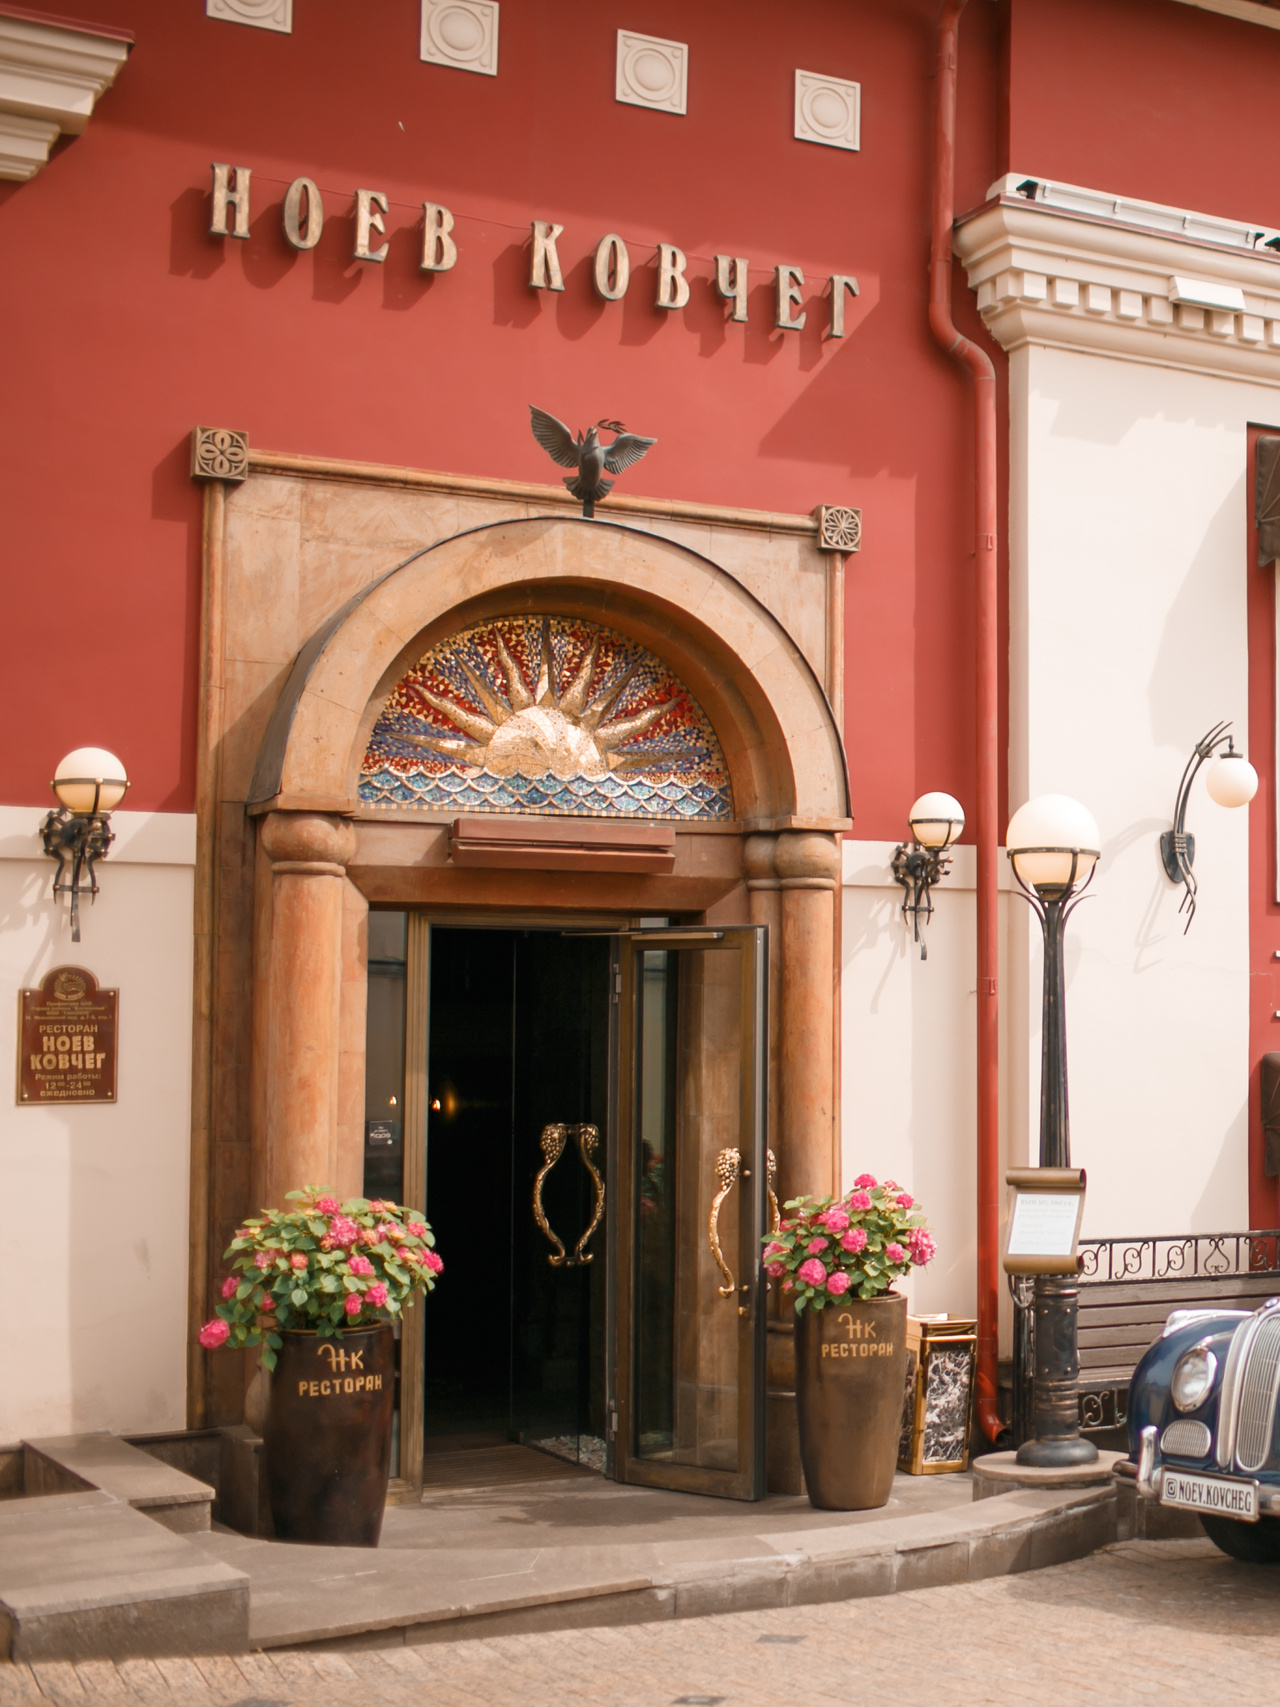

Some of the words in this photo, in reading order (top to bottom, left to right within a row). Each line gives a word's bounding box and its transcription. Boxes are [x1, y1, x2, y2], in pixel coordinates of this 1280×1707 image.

[208, 161, 458, 273] НОЕВ
[528, 220, 860, 338] КОВЧЕГ
[39, 1024, 98, 1033] РЕСТОРАН
[42, 1035, 95, 1052] НОЕВ
[30, 1052, 106, 1070] КОВЧЕГ
[35, 1073, 65, 1081] Режим
[40, 1089, 95, 1097] ежедневно
[821, 1342, 894, 1358] РЕСТОРАН
[298, 1373, 383, 1397] РЕСТОРАН
[1178, 1479, 1252, 1513] NOEV.KOVCHEG
